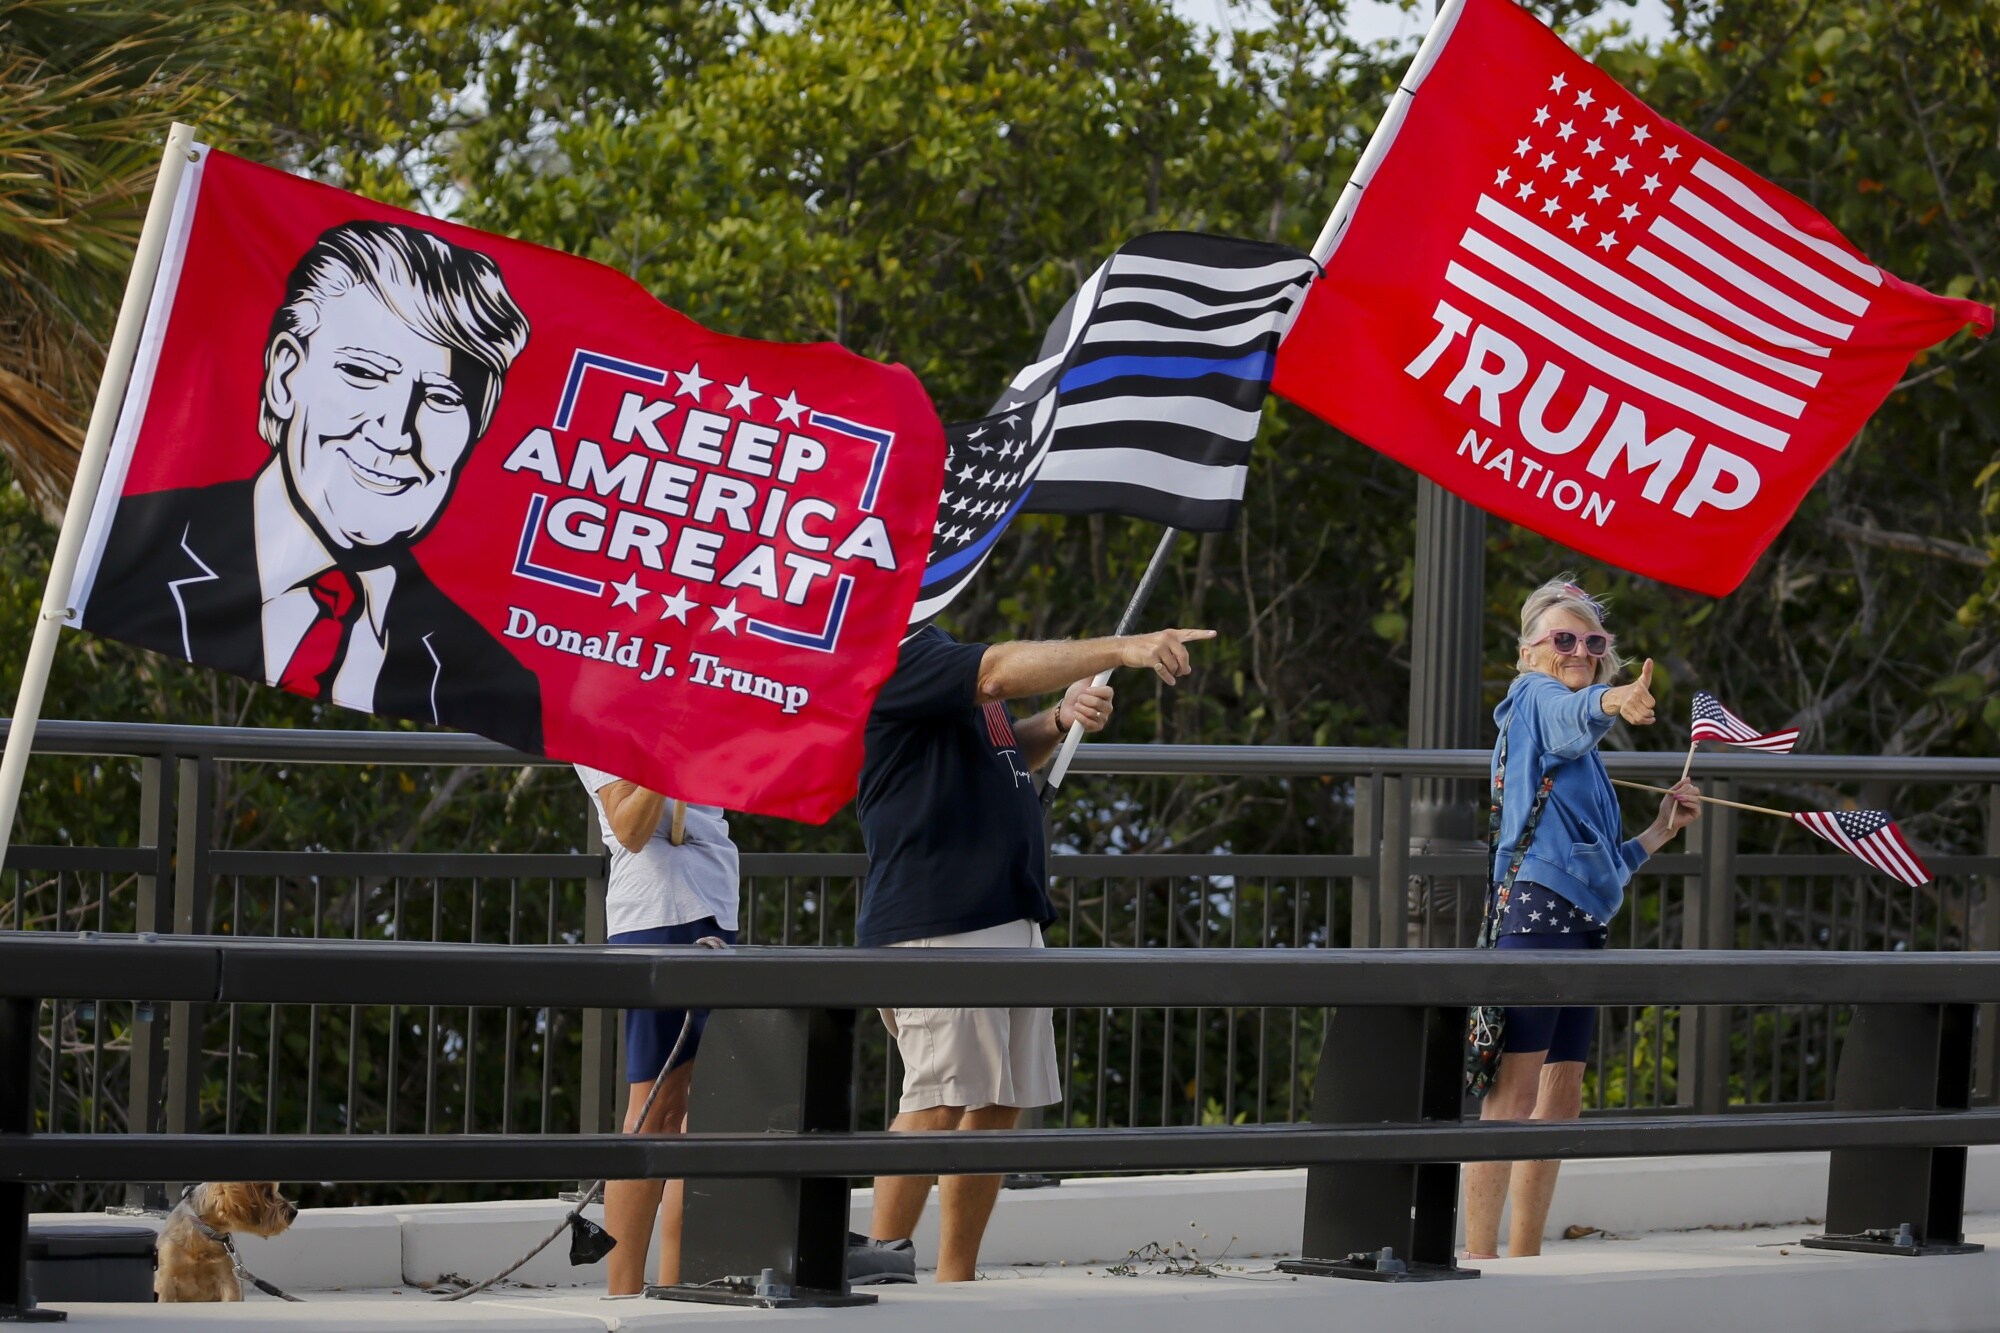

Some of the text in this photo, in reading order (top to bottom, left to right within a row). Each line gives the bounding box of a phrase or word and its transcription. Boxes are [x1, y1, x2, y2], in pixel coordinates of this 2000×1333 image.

[611, 391, 828, 485] KEEP
[1403, 299, 1761, 518] TRUMP
[502, 427, 897, 571] AMERICA
[1456, 428, 1616, 527] NATION
[545, 496, 833, 606] GREAT
[503, 605, 810, 715] Donald J. Trump
